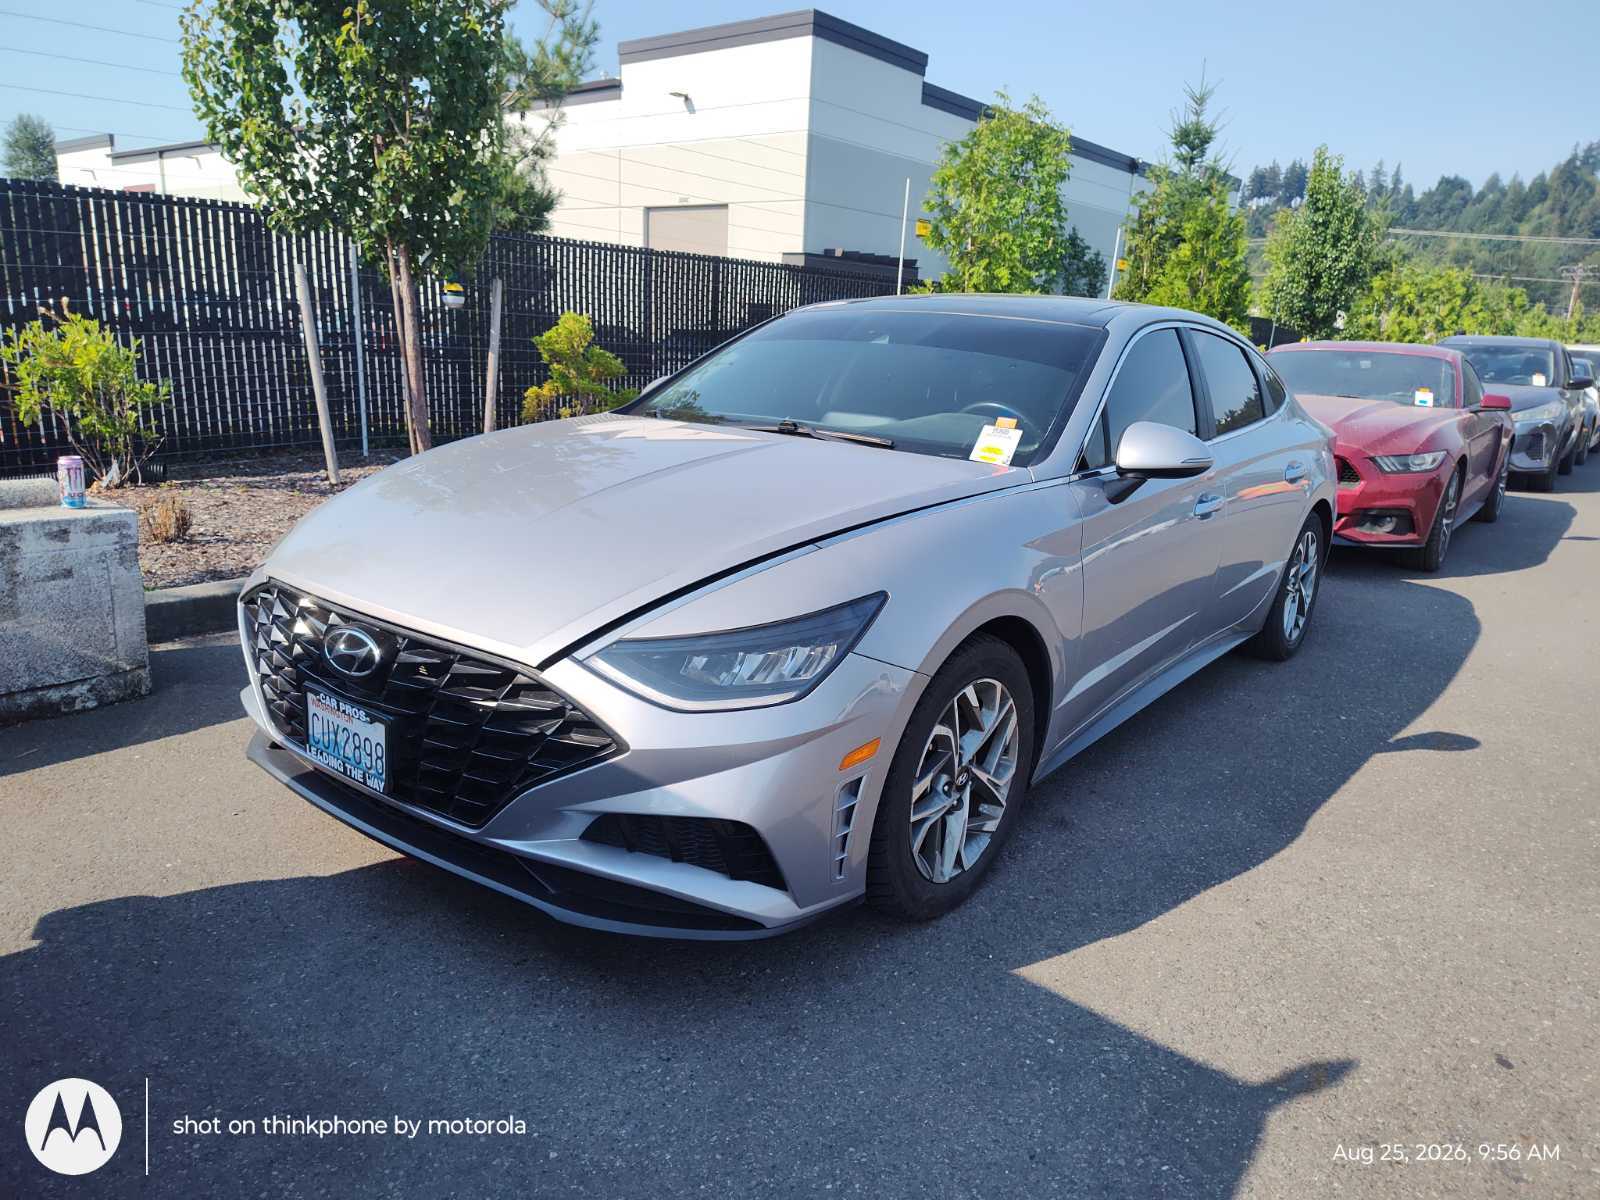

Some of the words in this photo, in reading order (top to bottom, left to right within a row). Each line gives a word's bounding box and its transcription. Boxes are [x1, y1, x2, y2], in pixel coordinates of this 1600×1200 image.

[319, 693, 338, 710] CAR
[340, 701, 366, 722] PROS
[306, 743, 343, 772] LEADING
[345, 762, 364, 783] THE
[365, 772, 385, 793] WAY
[311, 712, 384, 777] CUX2898
